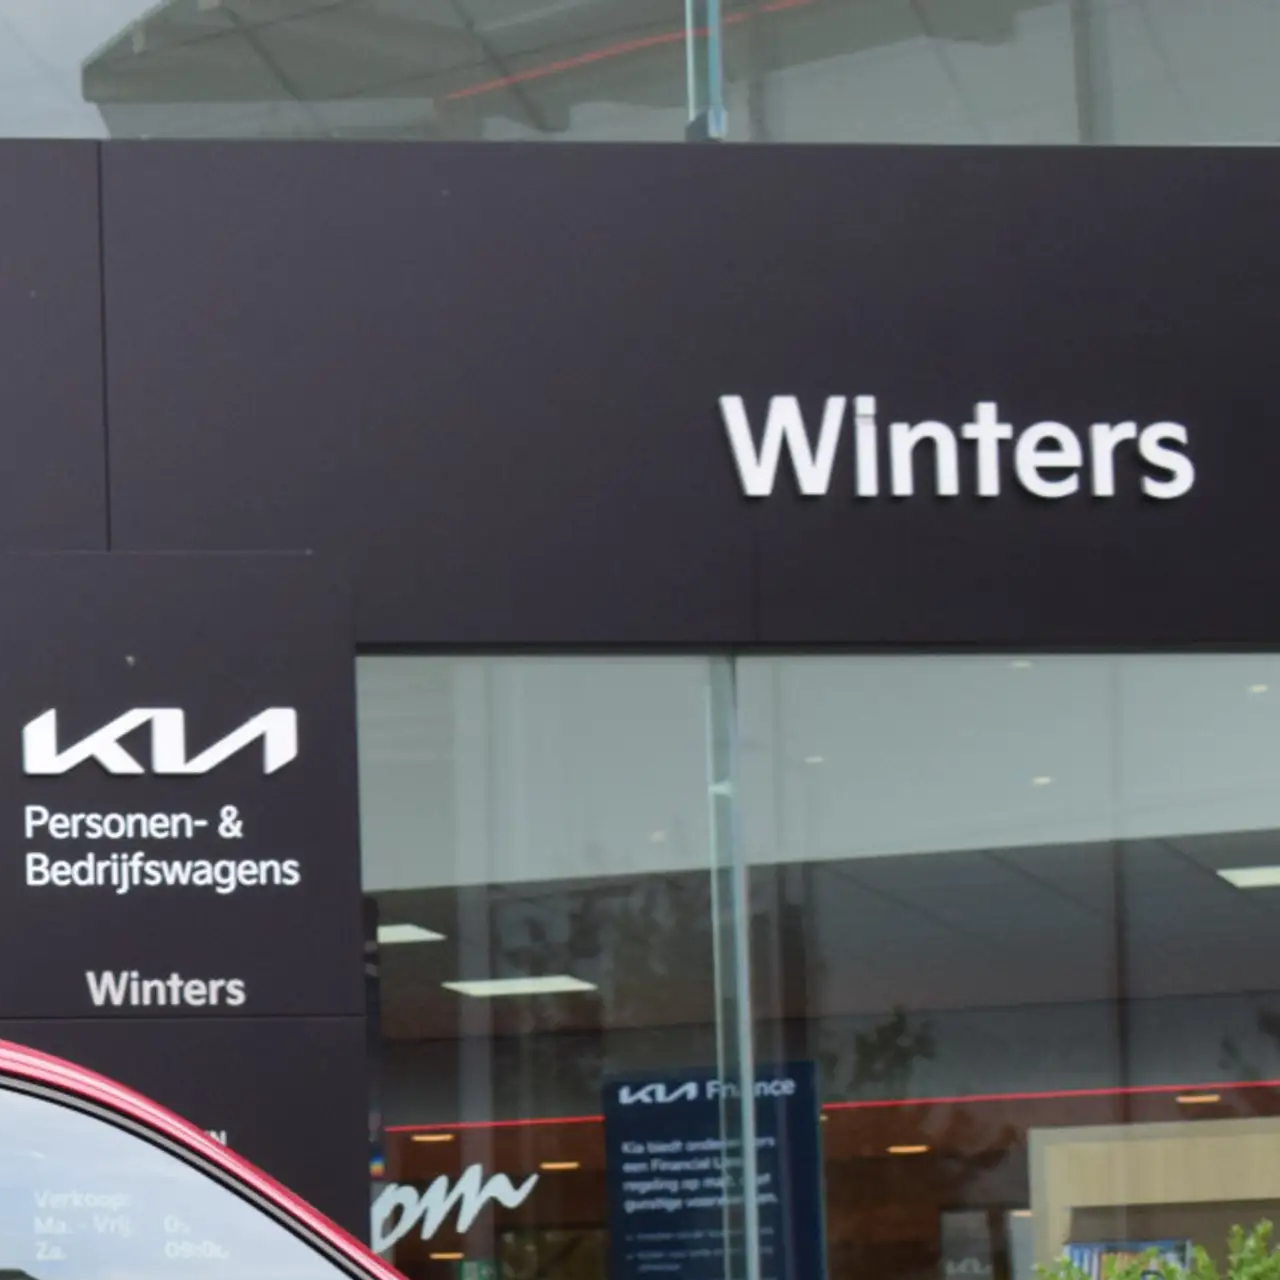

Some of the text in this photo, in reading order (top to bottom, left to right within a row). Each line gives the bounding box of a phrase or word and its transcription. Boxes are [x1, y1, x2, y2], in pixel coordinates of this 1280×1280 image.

[718, 395, 1195, 498] Winters
[23, 707, 297, 774] KIA
[24, 805, 243, 839] Personen- &
[25, 852, 300, 893] Bedrijfswagens
[86, 971, 246, 1006] Winters
[618, 1078, 796, 1105] KIA Fnnce
